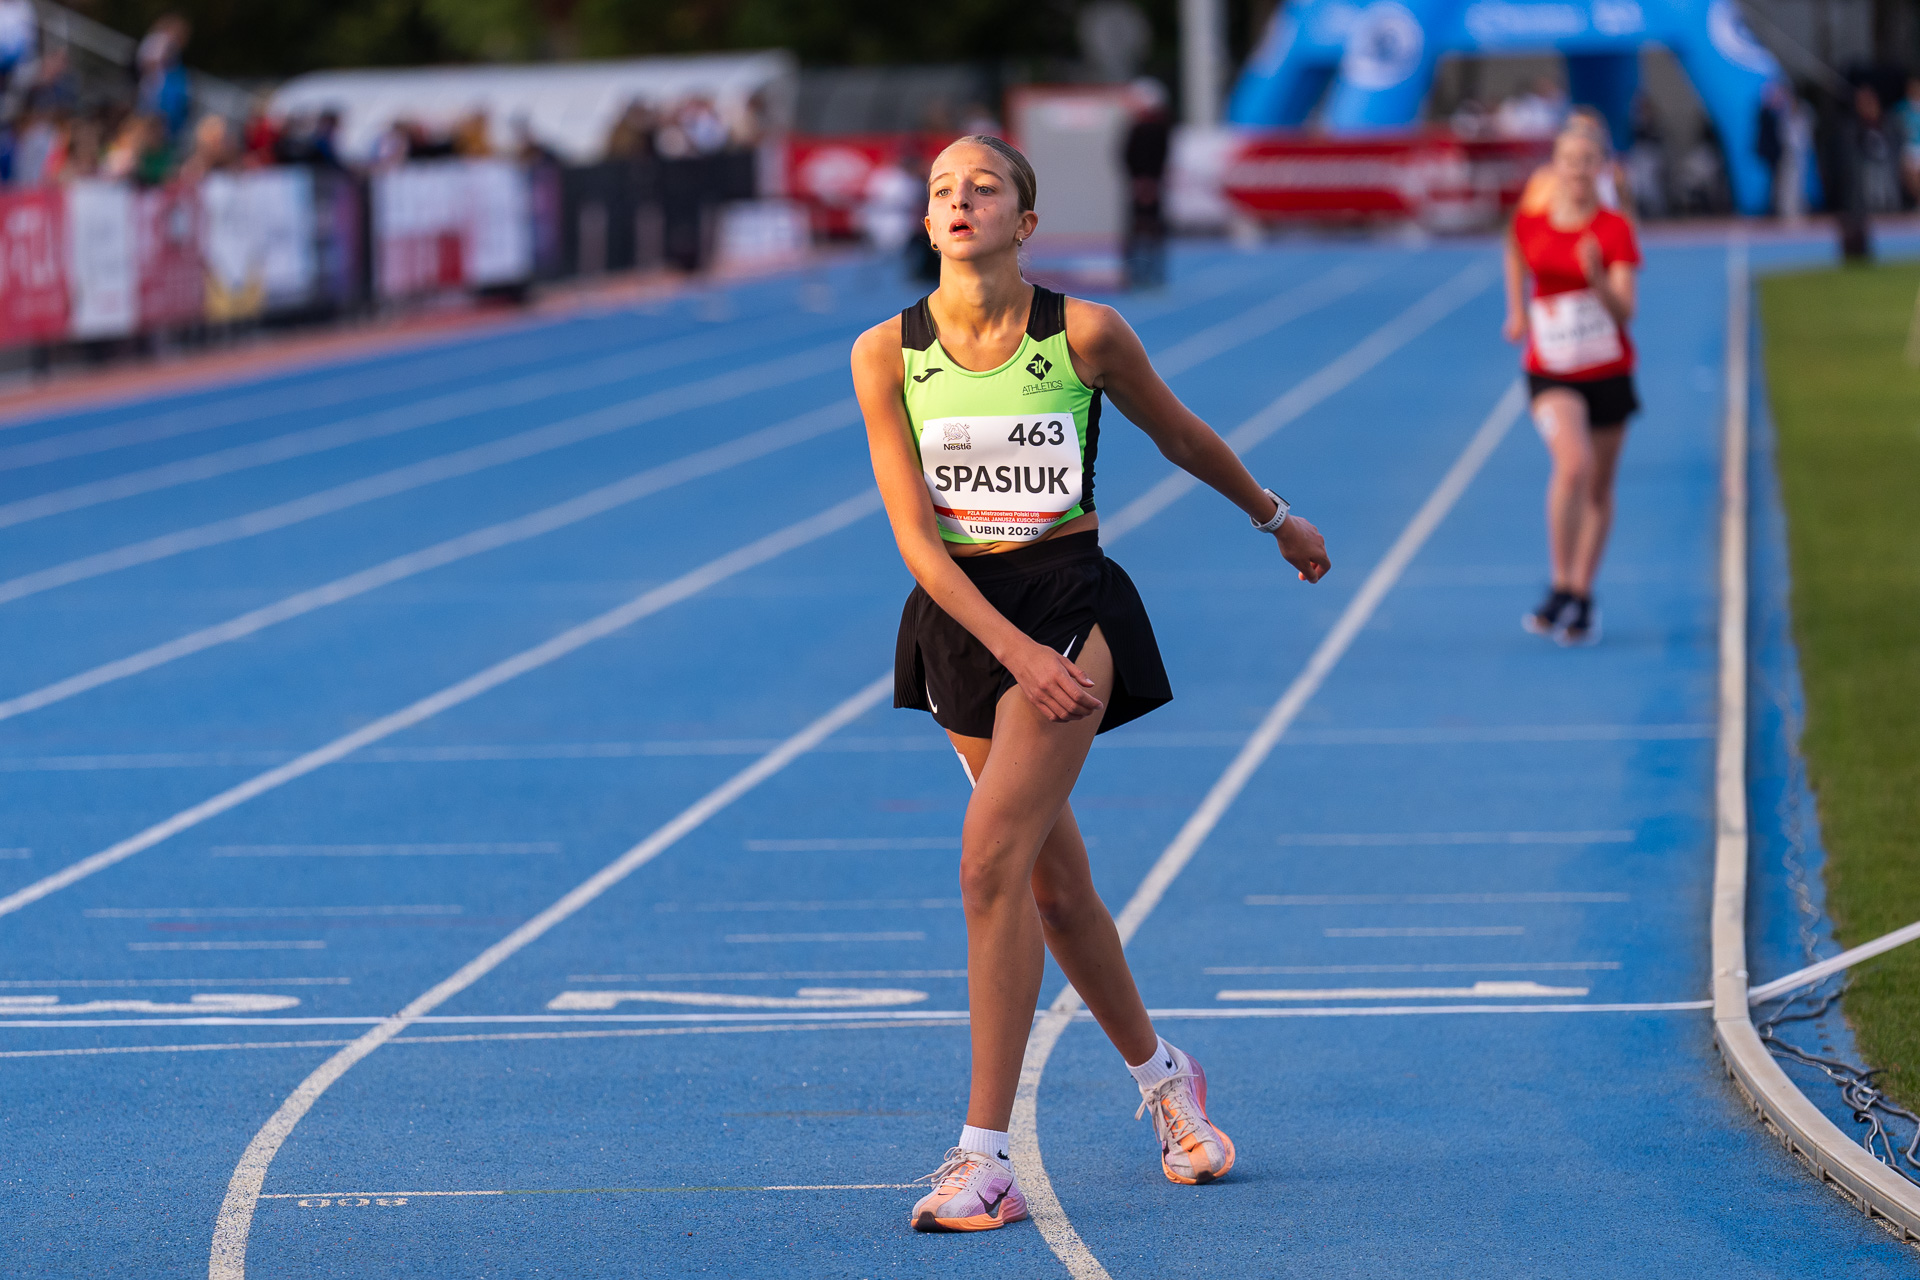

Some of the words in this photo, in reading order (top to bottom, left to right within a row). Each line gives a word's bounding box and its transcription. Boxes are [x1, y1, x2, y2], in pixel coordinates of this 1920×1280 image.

[1022, 380, 1063, 393] ATHLETICS
[1007, 420, 1065, 447] 463
[935, 465, 1070, 495] SPASIUK
[969, 525, 1005, 536] LUBIN
[1008, 526, 1039, 536] 2026
